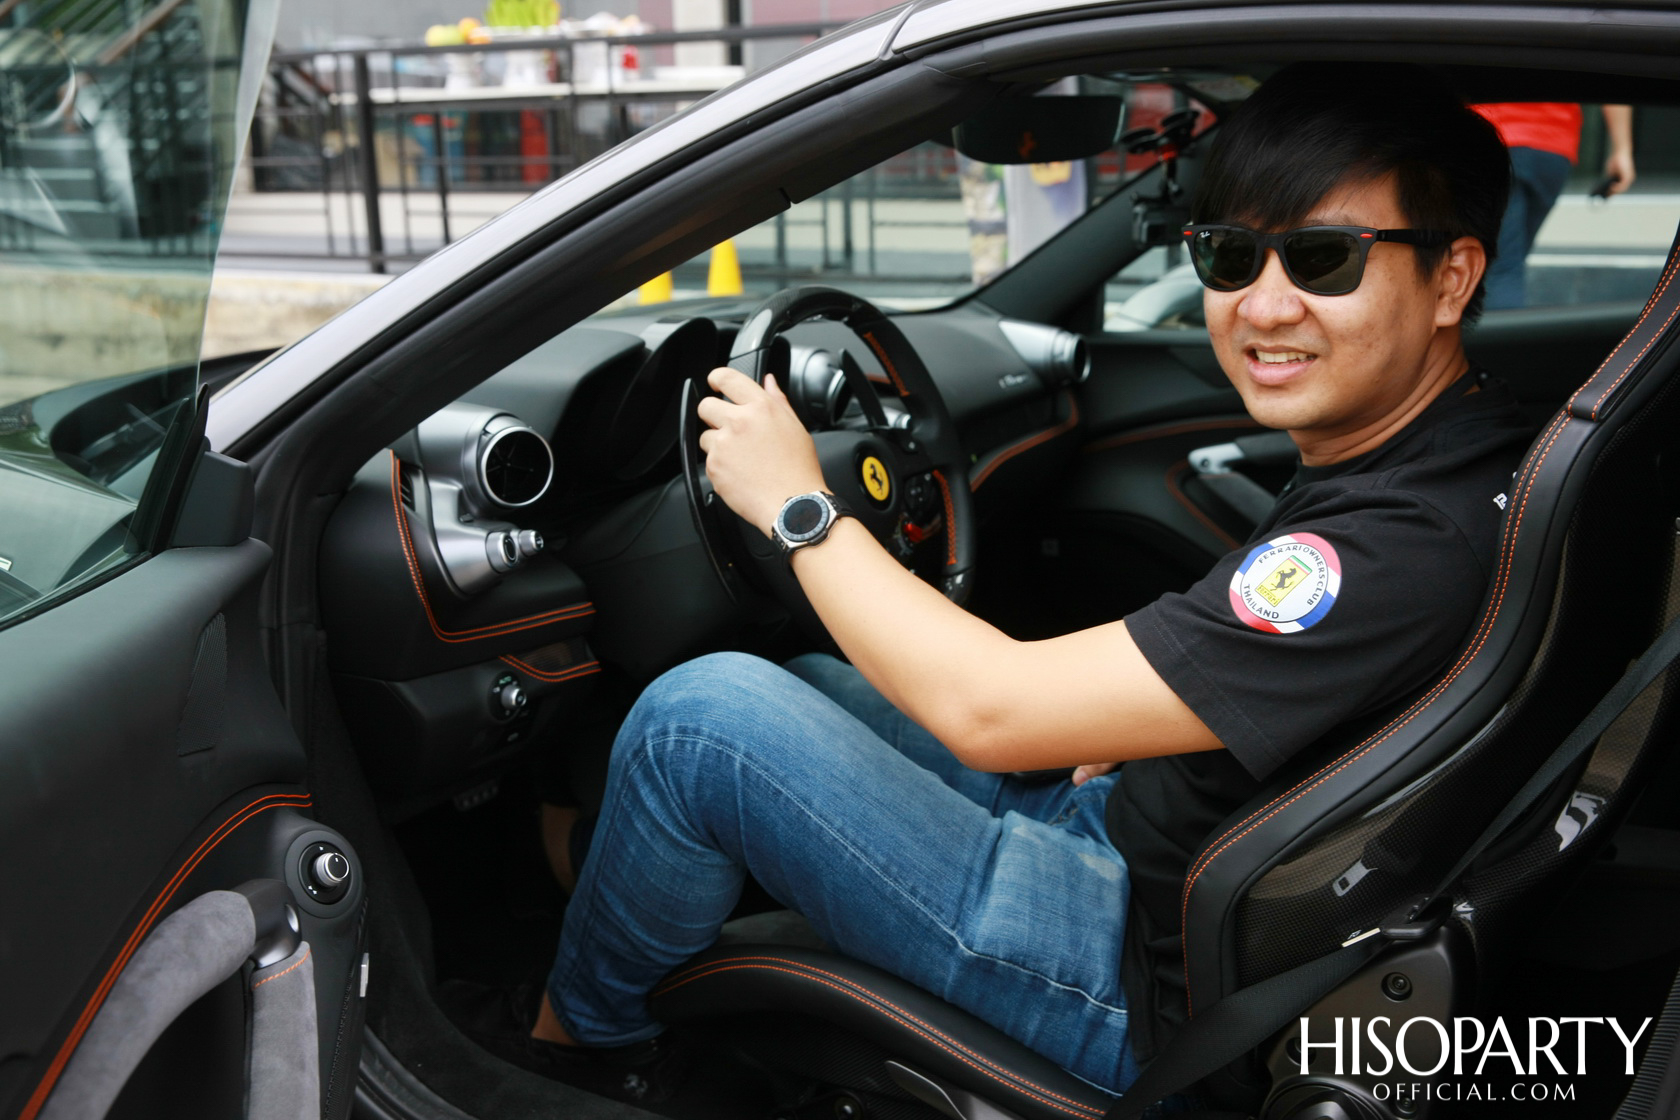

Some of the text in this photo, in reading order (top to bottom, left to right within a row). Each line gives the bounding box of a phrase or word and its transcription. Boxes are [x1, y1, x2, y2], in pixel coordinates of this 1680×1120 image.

[1258, 544, 1326, 605] FERRARI OWNERS CLUB
[1244, 583, 1280, 619] THAILAND
